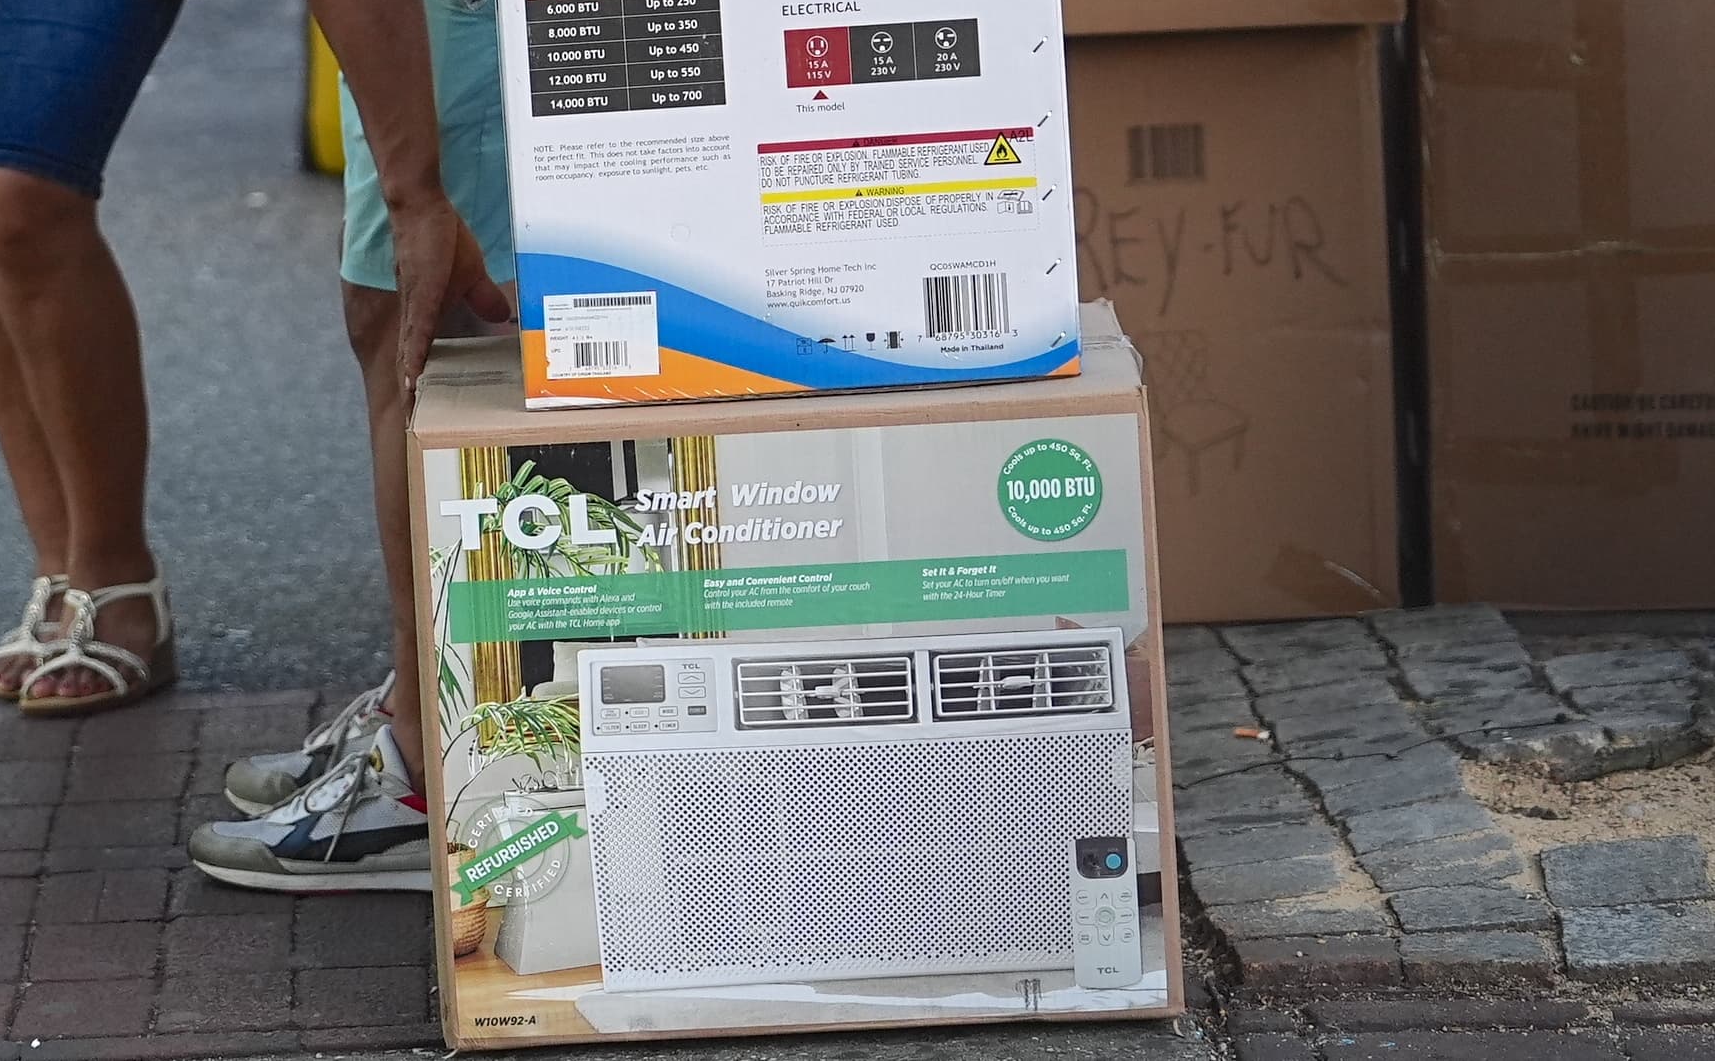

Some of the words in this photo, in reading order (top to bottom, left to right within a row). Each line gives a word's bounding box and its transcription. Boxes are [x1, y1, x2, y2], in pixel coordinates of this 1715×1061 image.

[546, 3, 575, 14] 6,000
[577, 1, 598, 12] BTU
[782, 1, 860, 16] ELECTRICAL
[548, 26, 577, 38] 8,000
[579, 25, 600, 36] BTU
[647, 22, 661, 33] Up
[664, 22, 675, 30] to
[678, 19, 697, 30] 350
[547, 50, 581, 62] 10,000
[584, 48, 605, 59] BTU
[648, 45, 663, 57] Up
[665, 45, 677, 54] to
[679, 42, 699, 53] 450
[873, 56, 884, 64] 15
[936, 52, 948, 61] 20
[949, 52, 957, 60] A
[808, 60, 819, 69] 15
[820, 59, 828, 68] A
[870, 66, 888, 75] 230
[889, 66, 896, 74] V
[934, 62, 952, 72] 230
[953, 62, 960, 70] V
[548, 74, 583, 85] 12,000
[585, 72, 606, 83] BTU
[650, 69, 664, 80] Up
[667, 69, 678, 78] to
[681, 66, 700, 77] 550
[806, 70, 822, 79] 115
[824, 70, 831, 78] V
[550, 97, 584, 109] 14,000
[587, 96, 608, 106] BTU
[651, 92, 666, 104] Up
[668, 92, 680, 101] to
[682, 90, 702, 100] 700
[795, 104, 814, 113] This
[817, 101, 844, 111] model
[866, 186, 904, 196] WARNING
[970, 343, 1003, 351] Thailand
[1004, 454, 1023, 475] Cools
[1024, 447, 1035, 456] up
[1049, 442, 1068, 452] 450
[634, 485, 717, 512] Smart
[731, 481, 842, 507] Window
[1006, 479, 1061, 504] 10,000
[1065, 477, 1095, 497] BTU
[439, 494, 616, 551] TCL
[1008, 506, 1027, 528] Cools
[1028, 524, 1040, 534] up
[1053, 524, 1070, 534] 450
[637, 524, 678, 548] Air
[684, 516, 844, 545] Conditioner
[922, 568, 938, 576] Set
[938, 567, 947, 576] It
[947, 566, 955, 575] &
[956, 565, 987, 575] Forget
[988, 564, 996, 573] It
[703, 578, 725, 588] Easy
[726, 576, 746, 586] and
[745, 575, 797, 585] Convenient
[798, 572, 832, 582] Control
[506, 588, 526, 598] App
[527, 587, 534, 596] &
[536, 585, 562, 595] Voice
[562, 584, 597, 594] Control
[465, 821, 559, 882] REFURBISHED
[494, 860, 561, 897] CERTIFIED
[1096, 966, 1120, 975] TCL
[474, 1015, 536, 1026] W10W92-A
